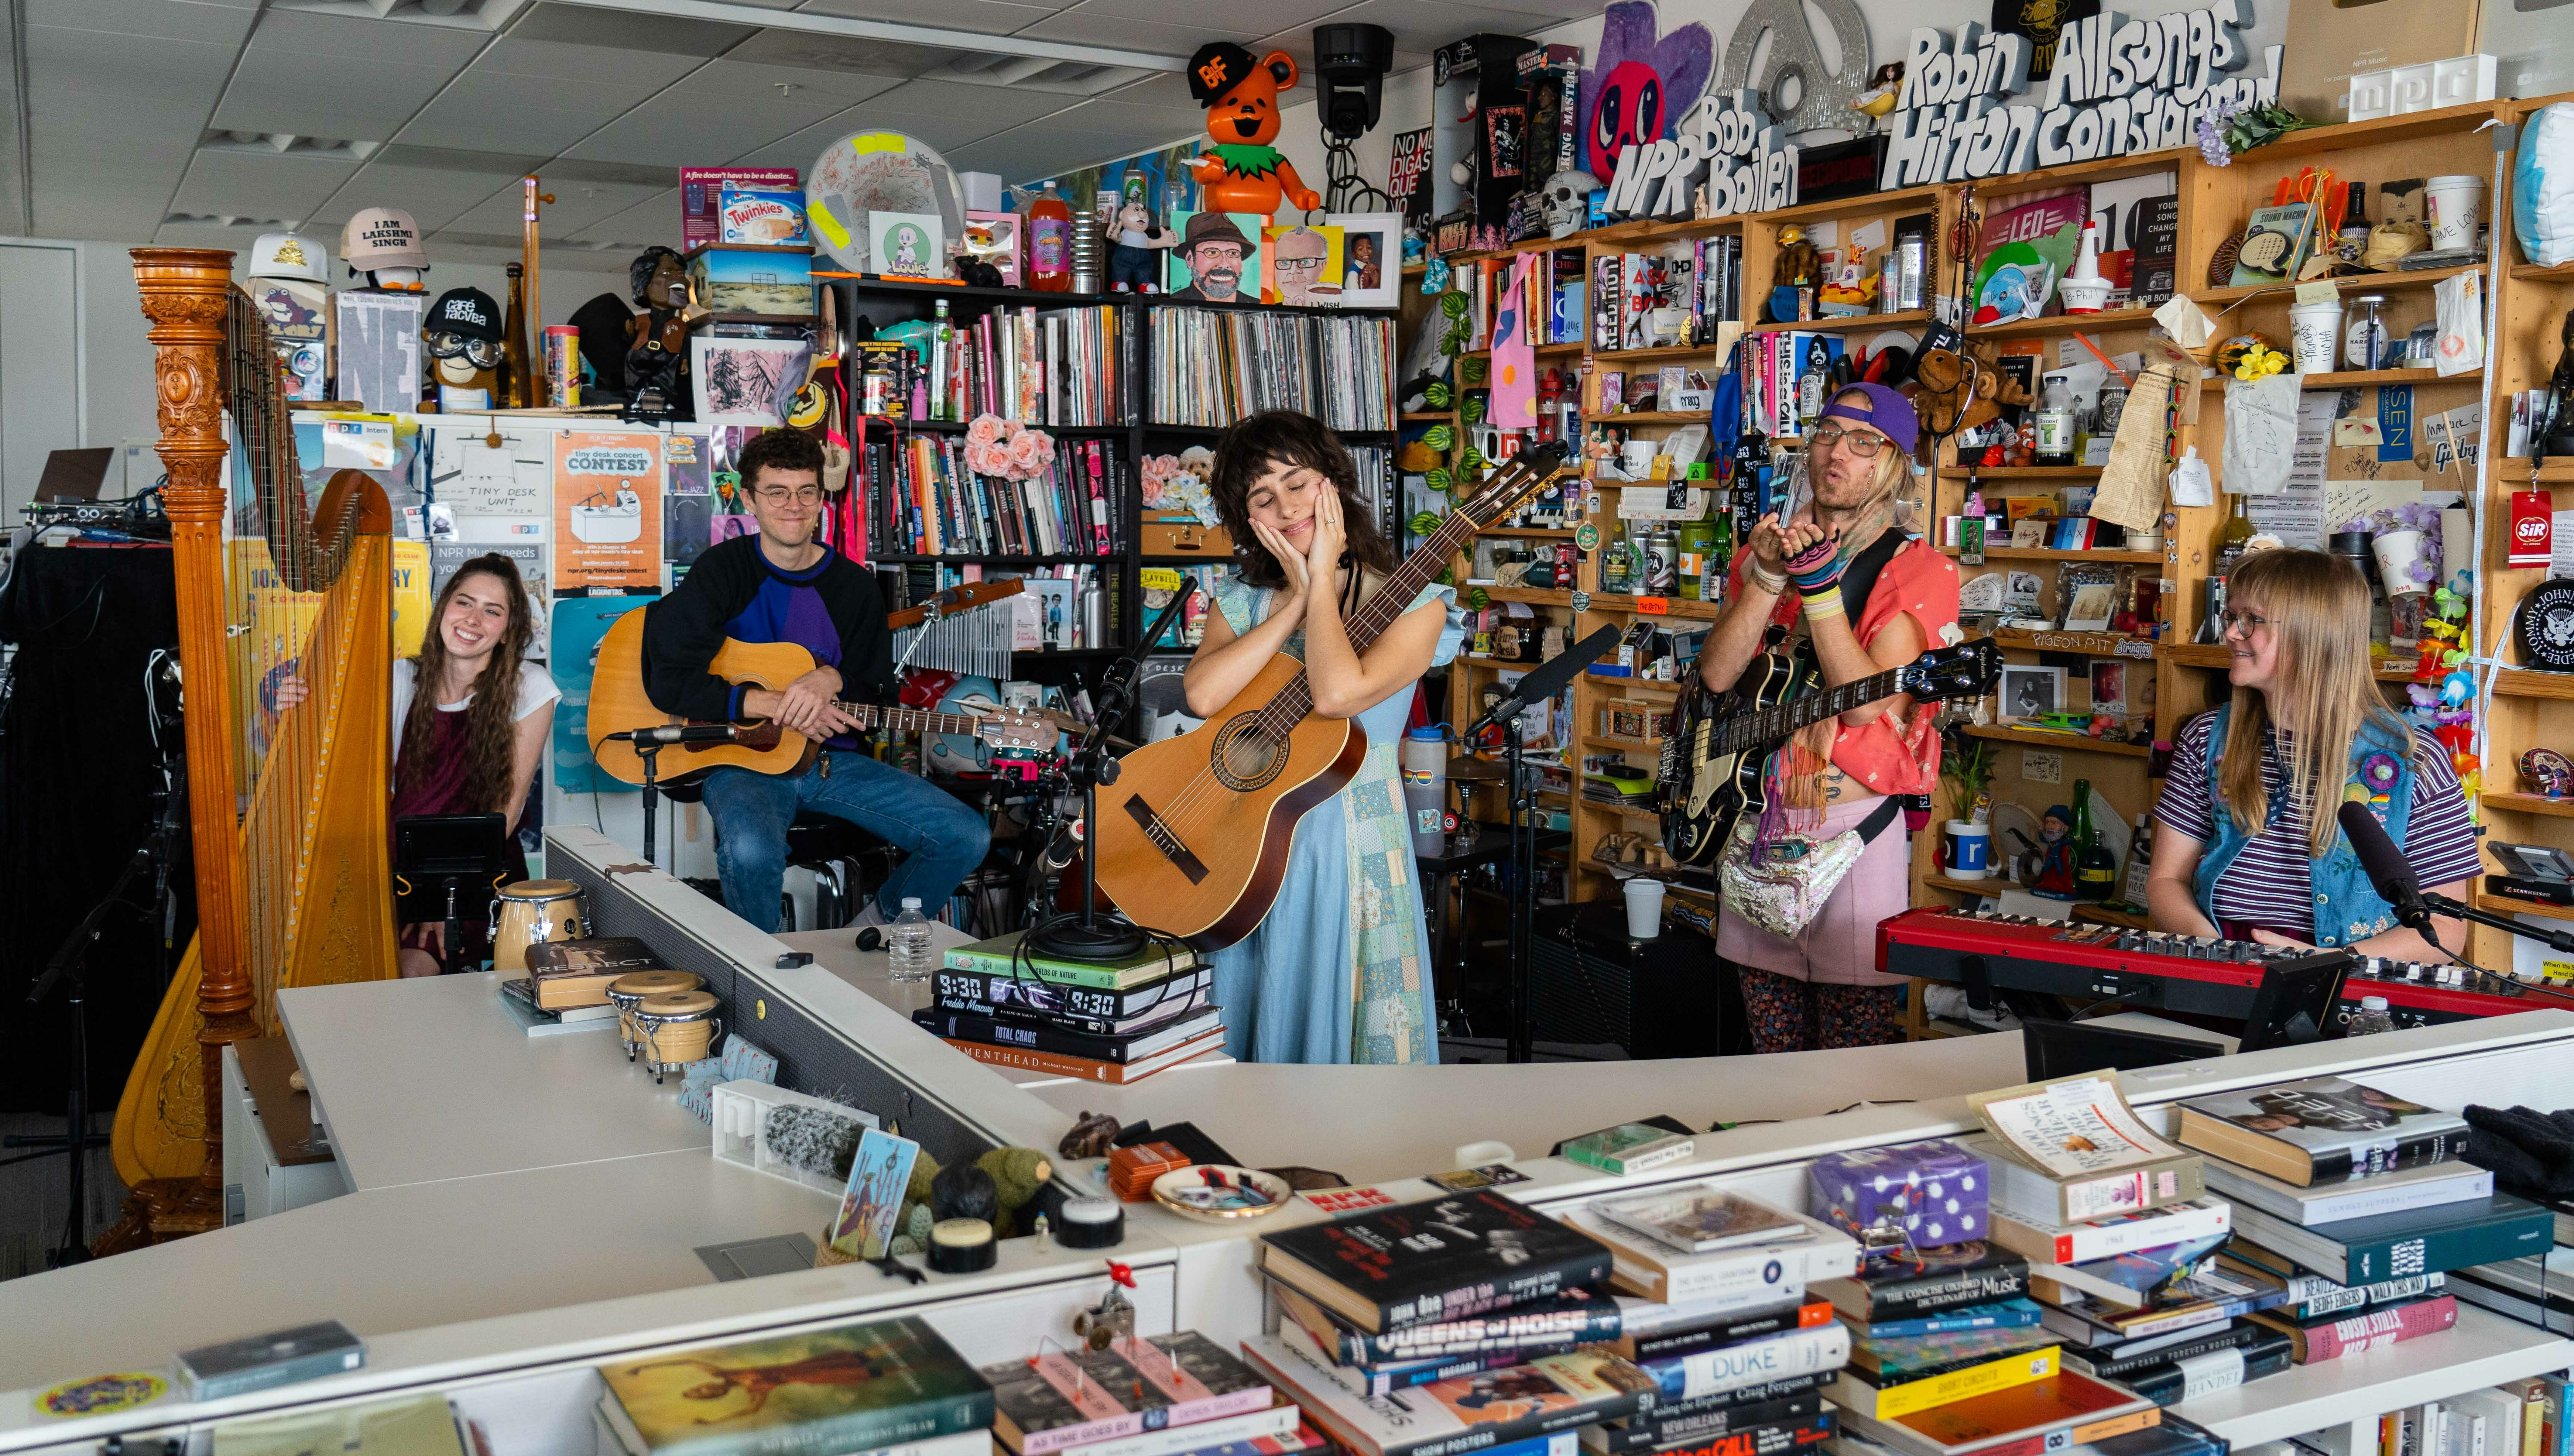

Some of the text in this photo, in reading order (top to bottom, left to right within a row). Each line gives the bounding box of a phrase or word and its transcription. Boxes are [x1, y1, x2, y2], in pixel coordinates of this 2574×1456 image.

[2042, 0, 2238, 114] Allsongs
[2353, 56, 2388, 68] NPR Music
[1897, 27, 2020, 113] Robin
[1564, 56, 1576, 126] MASTER P
[2361, 68, 2470, 115] npr
[1700, 89, 1757, 159] Bob
[1394, 134, 1415, 157] NO
[1881, 103, 2040, 190] Hilton
[1392, 152, 1431, 177] DIGAS
[1708, 126, 1799, 218] Boilen
[1602, 135, 1700, 217] NPR
[1389, 175, 1419, 198] QUE
[731, 196, 754, 204] Hostess
[2157, 202, 2179, 210] YOUR
[728, 202, 783, 227] Twinkies
[2156, 212, 2177, 221] SONG
[362, 230, 412, 239] LAKSHMI
[2009, 207, 2045, 243] LED
[372, 239, 407, 247] SINGH
[1439, 221, 1467, 253] KISS
[2159, 234, 2170, 242] MY
[2156, 244, 2172, 253] LIFE
[891, 264, 928, 275] Louie
[1632, 268, 1669, 285] ASK
[1565, 322, 1580, 333] LOUIE
[1680, 395, 1699, 410] moog
[328, 423, 361, 433] npr
[2040, 424, 2056, 444] T
[568, 458, 649, 471] CONTEST
[469, 487, 537, 497] TINY DESK
[688, 485, 705, 494] JAZZ
[487, 497, 516, 506] UNIT
[2518, 523, 2545, 537] SiR
[439, 547, 466, 557] NPR
[502, 547, 535, 558] needs
[1960, 554, 1982, 564] PRODUCTION
[1140, 572, 1179, 584] PLAYBILL
[1110, 571, 1119, 629] THE BEATLES
[2525, 607, 2543, 655] TOMMY
[2033, 633, 2111, 652] PIGEON PIT
[2115, 640, 2152, 659] Stringjoy
[1979, 646, 1988, 679] Epiphone
[2513, 888, 2551, 898] SENNHEISER
[536, 958, 652, 973] RESPECT
[1059, 970, 1077, 980] NATURE
[940, 974, 982, 999] 9:30
[942, 996, 994, 1017] Freddie Mercury
[1071, 991, 1114, 1016] 9:30
[995, 1026, 1036, 1044] TOTAL CHAOS
[1062, 1064, 1083, 1072] Weintrob
[2327, 1196, 2400, 1214] SUNDAY SUPPERS
[1886, 1278, 1981, 1304] THE CONCISE OXFORD
[1981, 1274, 2021, 1297] Music
[2371, 1275, 2426, 1302] WALK THIS WAY
[1917, 1288, 1980, 1308] DICTIONARY OF
[2313, 1289, 2361, 1313] GEOFF EDGERS
[1487, 1321, 1507, 1337] of
[1508, 1310, 1588, 1336] NOISE
[2337, 1308, 2405, 1342] CROSBY, STILLS,
[1712, 1347, 1777, 1380] DUKE
[2102, 1336, 2236, 1375] JOHNNY CASH FOREVER WORDS
[1736, 1376, 1814, 1400] Craig Ferguson
[1963, 1369, 1998, 1388] CIRCUITS
[2186, 1372, 2241, 1398] HANDEL
[1680, 1398, 1694, 1411] the
[1032, 1437, 1046, 1449] AS
[1048, 1432, 1077, 1446] TIME
[1081, 1426, 1109, 1441] GOES
[1113, 1421, 1130, 1436] BY
[1412, 1431, 1496, 1456] SHOW POSTERS
